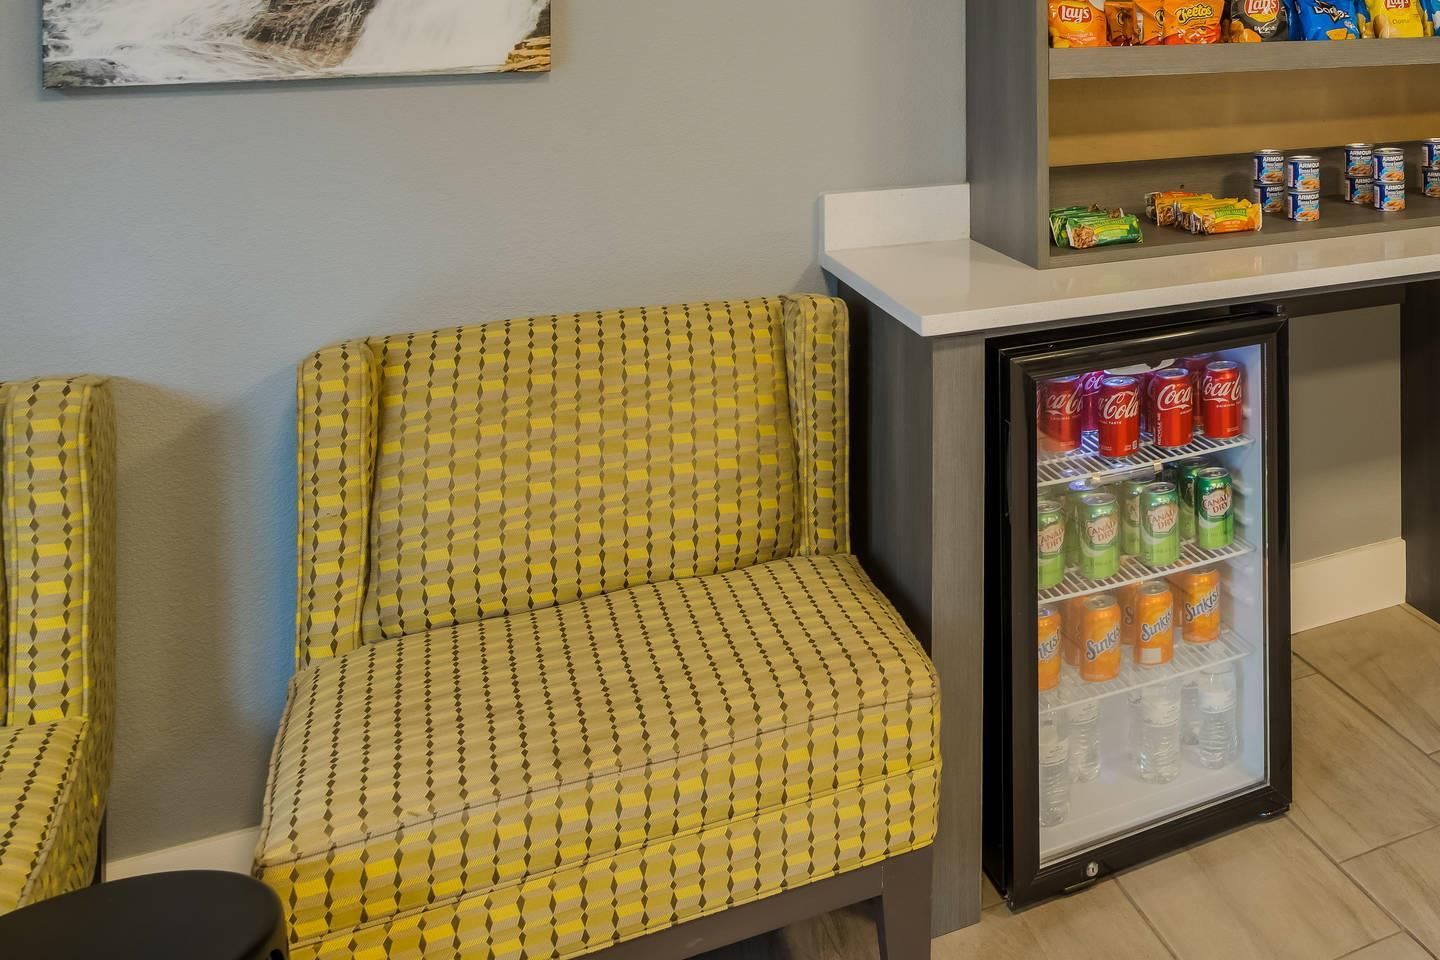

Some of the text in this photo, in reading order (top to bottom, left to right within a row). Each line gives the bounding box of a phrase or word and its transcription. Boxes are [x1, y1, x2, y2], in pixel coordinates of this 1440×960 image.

[1176, 4, 1213, 23] Cheetos
[1212, 501, 1228, 514] DRY
[1157, 518, 1174, 529] DRY
[1097, 529, 1114, 542] DRY
[1046, 537, 1062, 550] DRY
